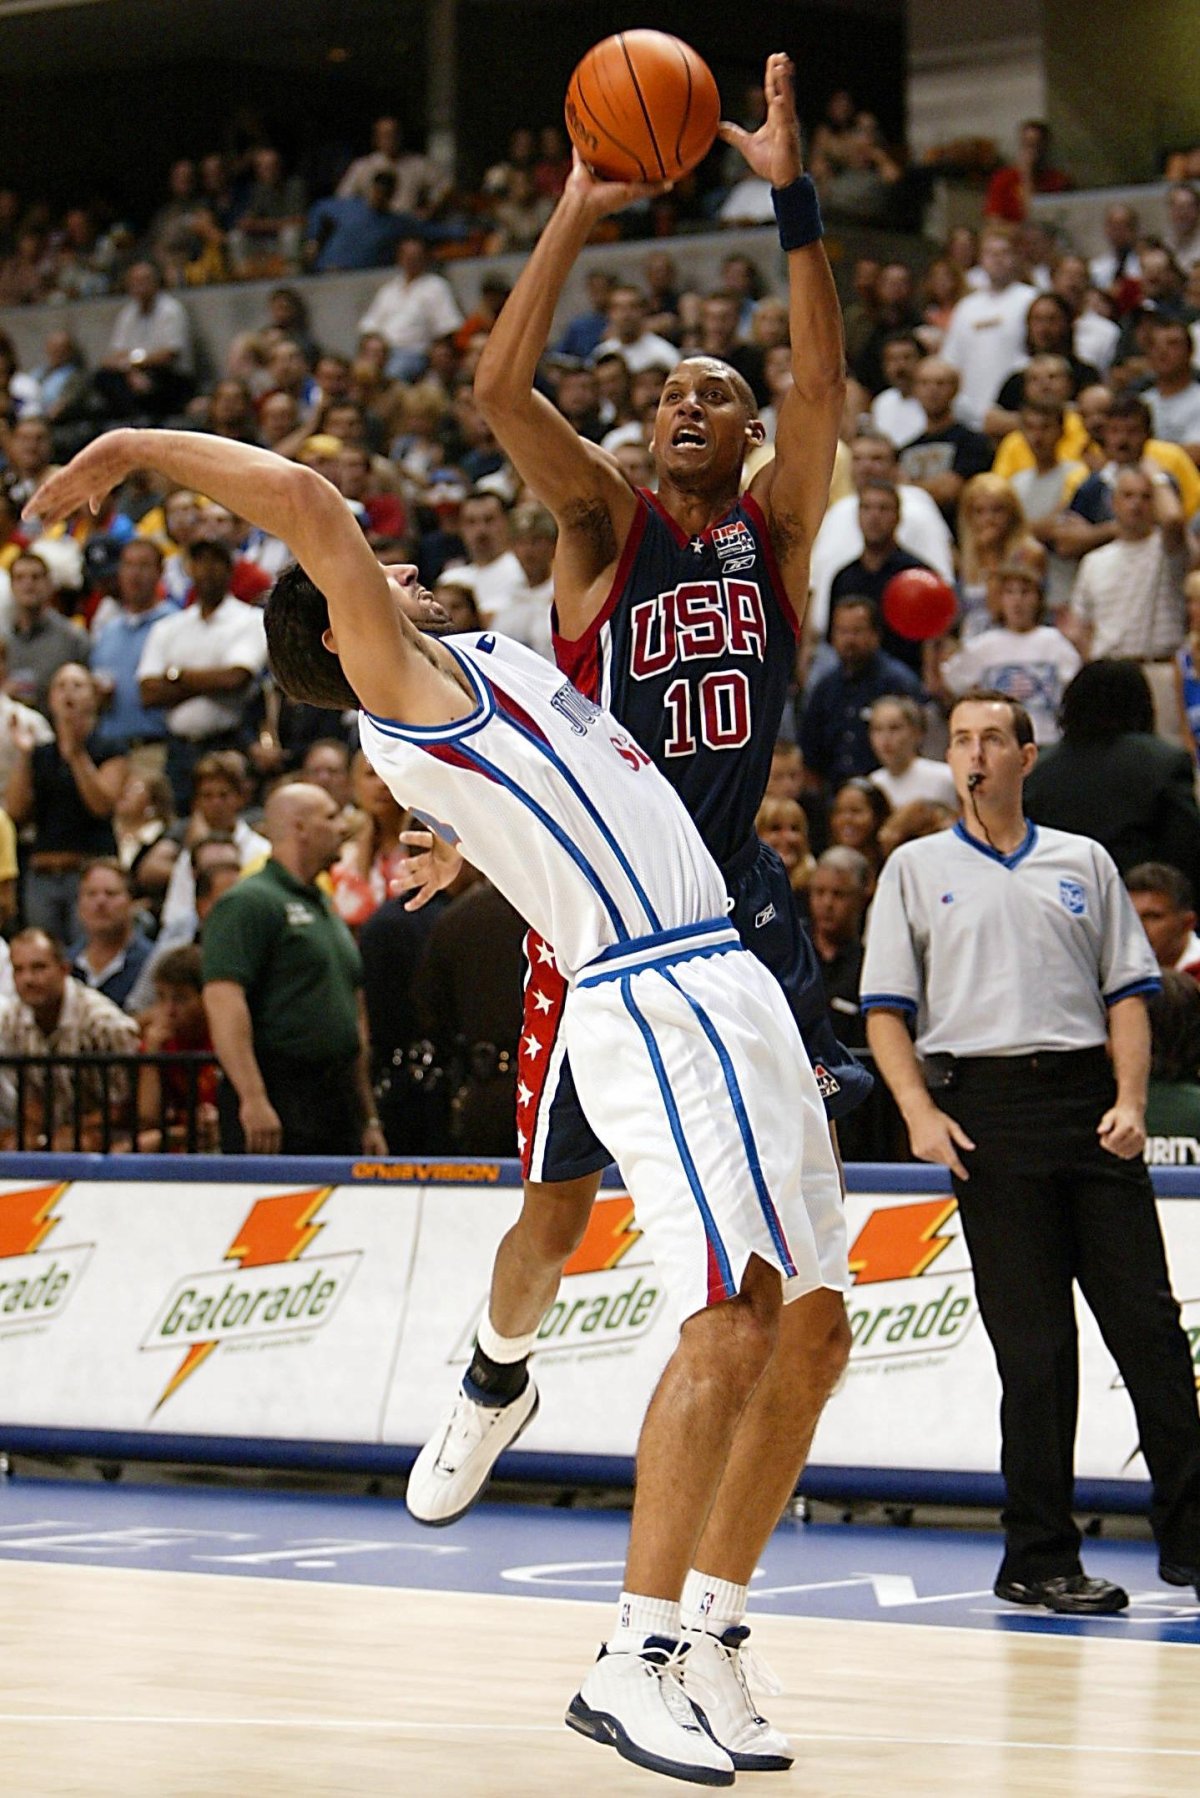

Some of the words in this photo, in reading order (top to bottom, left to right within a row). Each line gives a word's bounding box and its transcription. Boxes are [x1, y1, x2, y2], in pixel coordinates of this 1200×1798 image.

[712, 521, 756, 550] USA
[630, 578, 766, 681] USA
[664, 669, 751, 757] 10
[0, 1262, 69, 1312] ade
[160, 1269, 336, 1336] Gatorade
[537, 1278, 657, 1339] orade
[848, 1284, 970, 1346] orade
